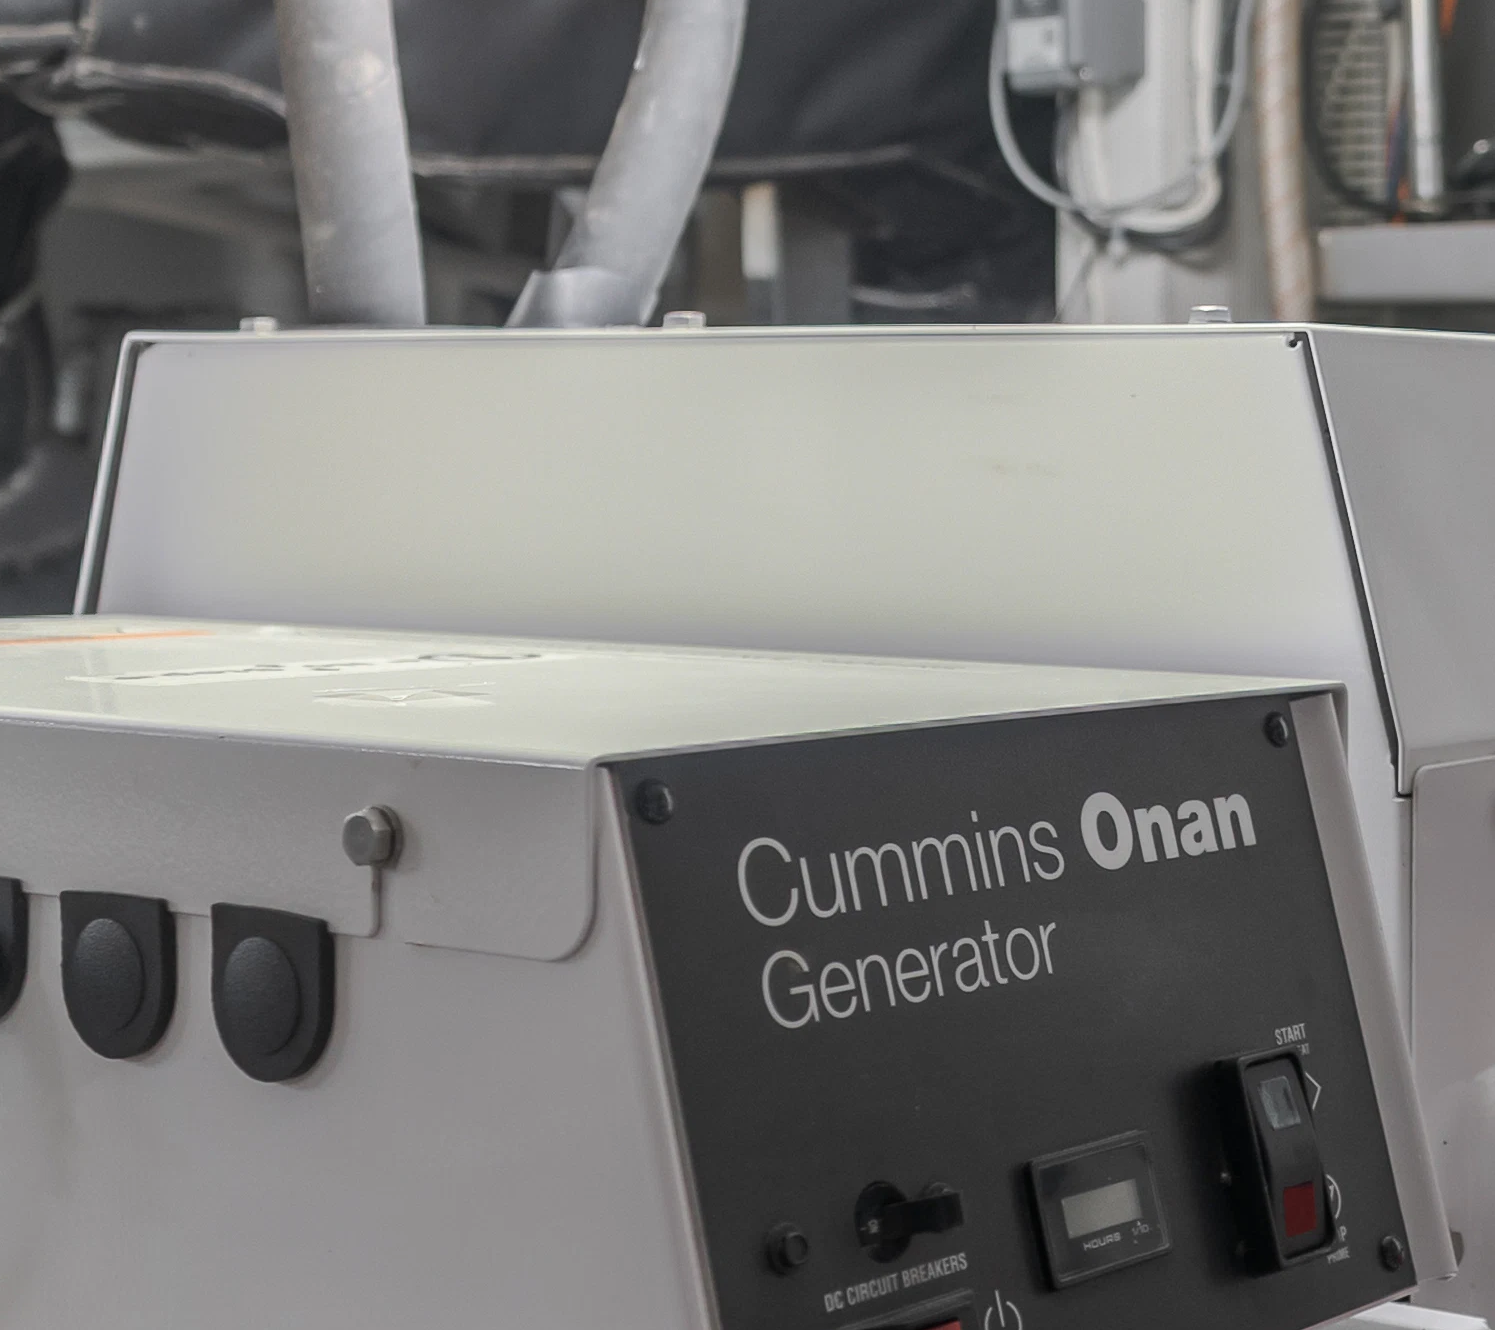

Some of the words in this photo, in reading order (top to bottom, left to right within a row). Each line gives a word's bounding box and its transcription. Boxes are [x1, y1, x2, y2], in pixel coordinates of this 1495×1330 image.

[737, 811, 1066, 927] Cummins
[1079, 791, 1258, 871] Onan
[760, 921, 1058, 1030] Generator
[1274, 1023, 1307, 1046] START
[1082, 1232, 1122, 1251] HOURS
[823, 1290, 845, 1313] DC
[846, 1272, 899, 1307] CIRCUIT
[902, 1252, 969, 1289] BREAKERS
